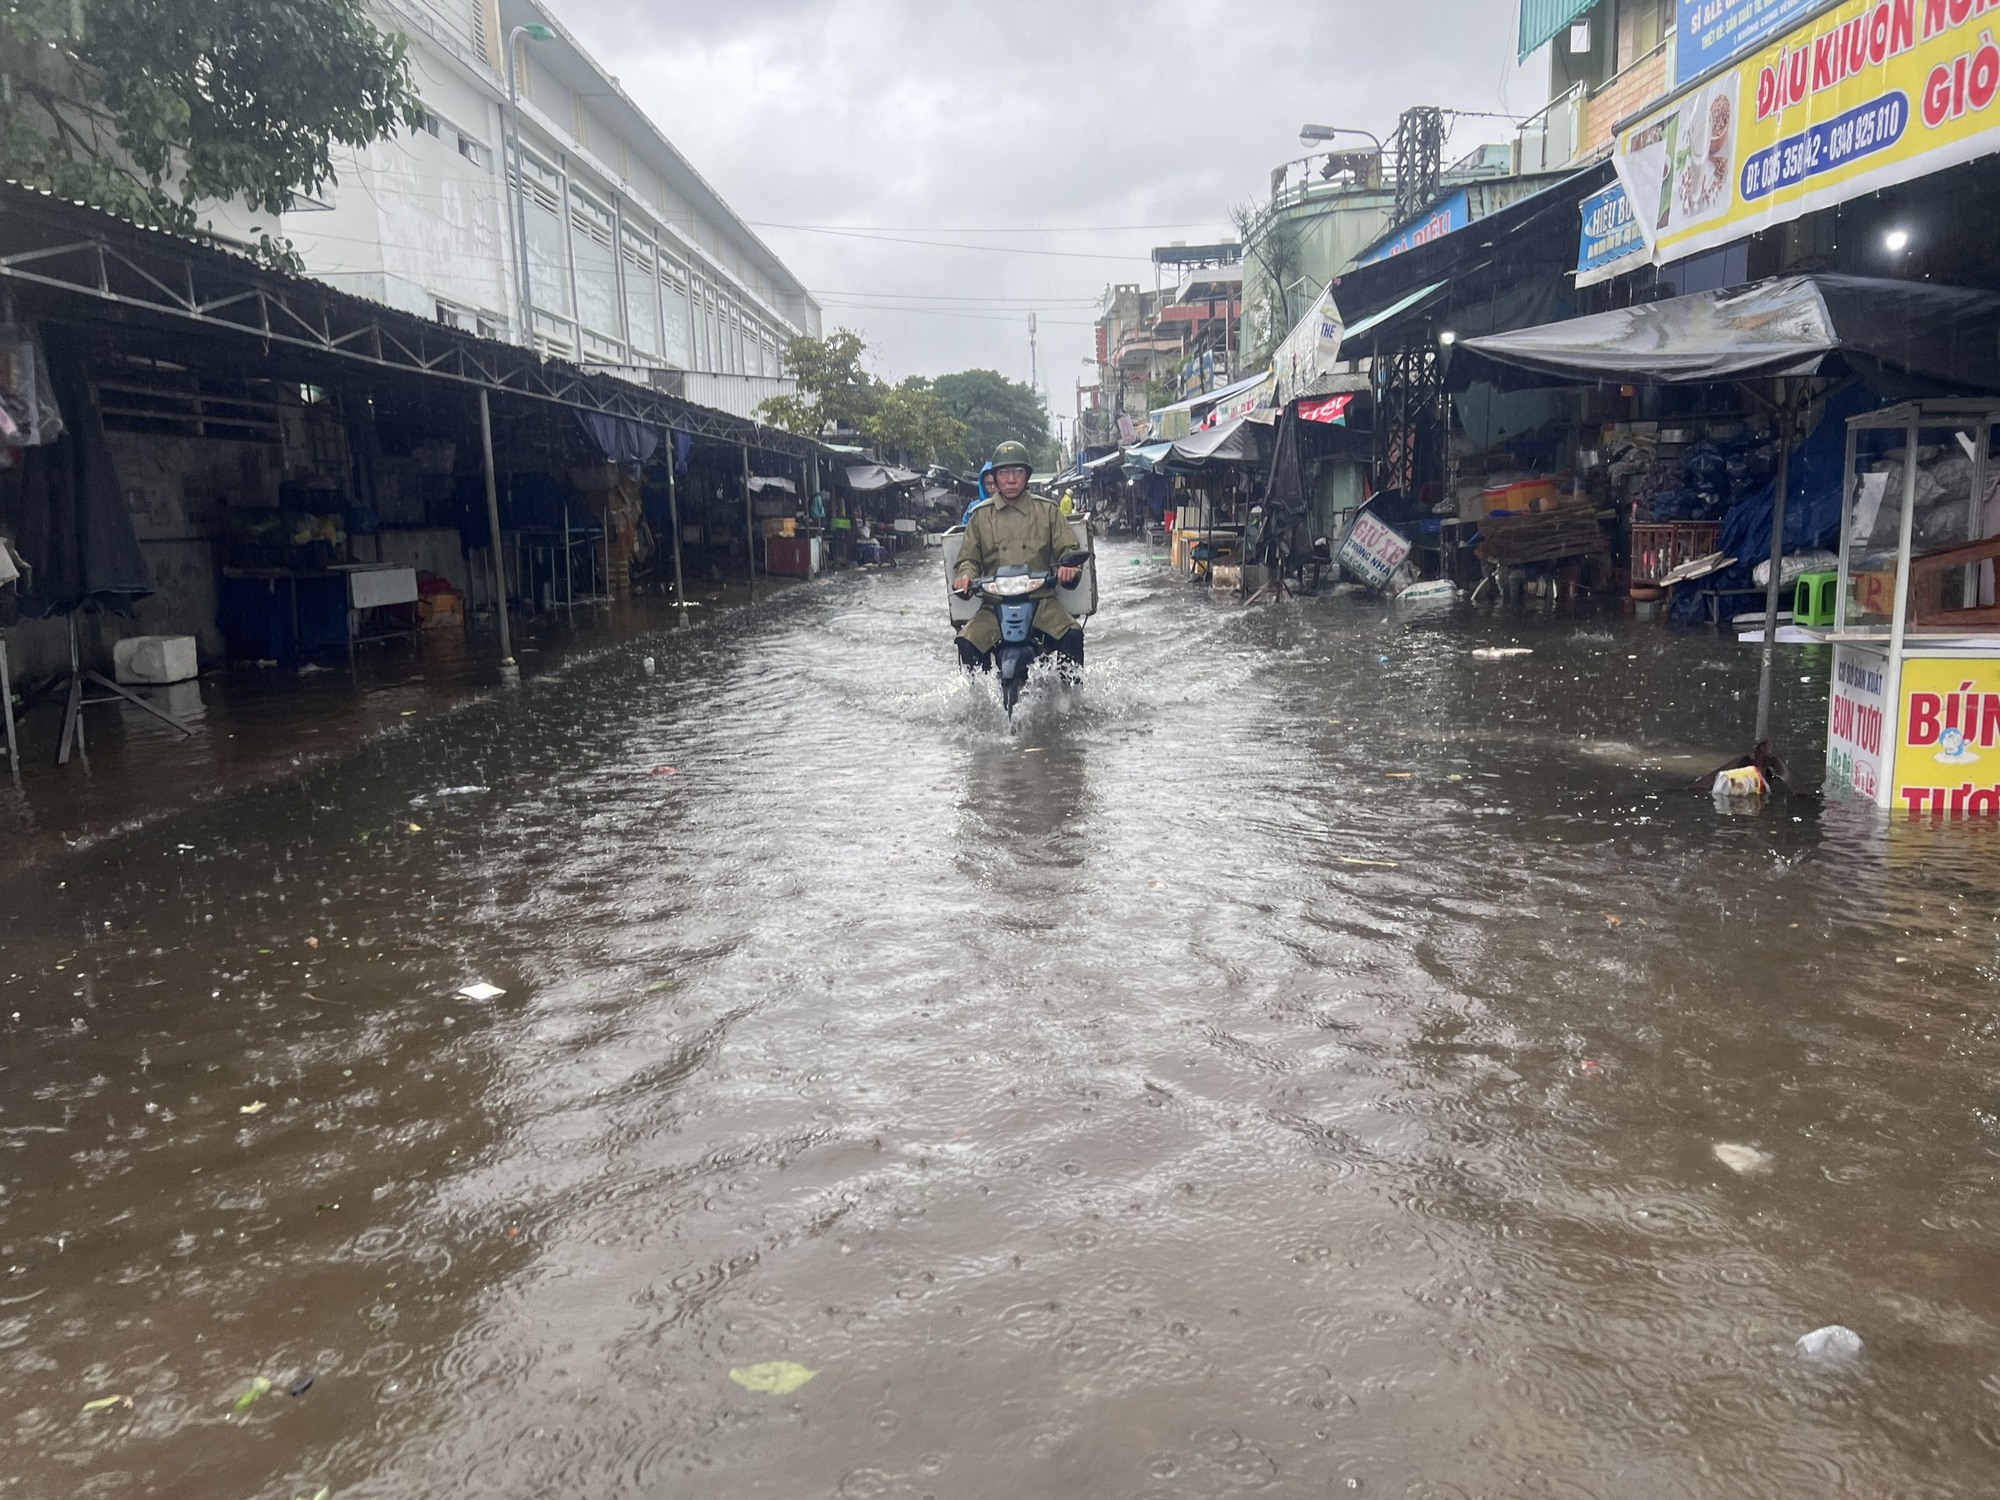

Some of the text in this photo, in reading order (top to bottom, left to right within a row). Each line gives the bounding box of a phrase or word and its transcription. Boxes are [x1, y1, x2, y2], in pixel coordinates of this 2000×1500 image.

[1757, 45, 1809, 125] ĐẬU
[1923, 31, 2000, 126] GIÒ
[1746, 161, 1761, 195] ĐT:
[1829, 120, 1854, 161] 0348
[1854, 110, 1876, 151] 925
[1876, 100, 1900, 142] 810
[1347, 538, 1371, 561] TRONG
[1370, 556, 1392, 577] NHÀ
[1353, 520, 1389, 549] GIỮ
[1377, 538, 1406, 567] XE
[1833, 688, 1883, 757] BÚN TƯƠI
